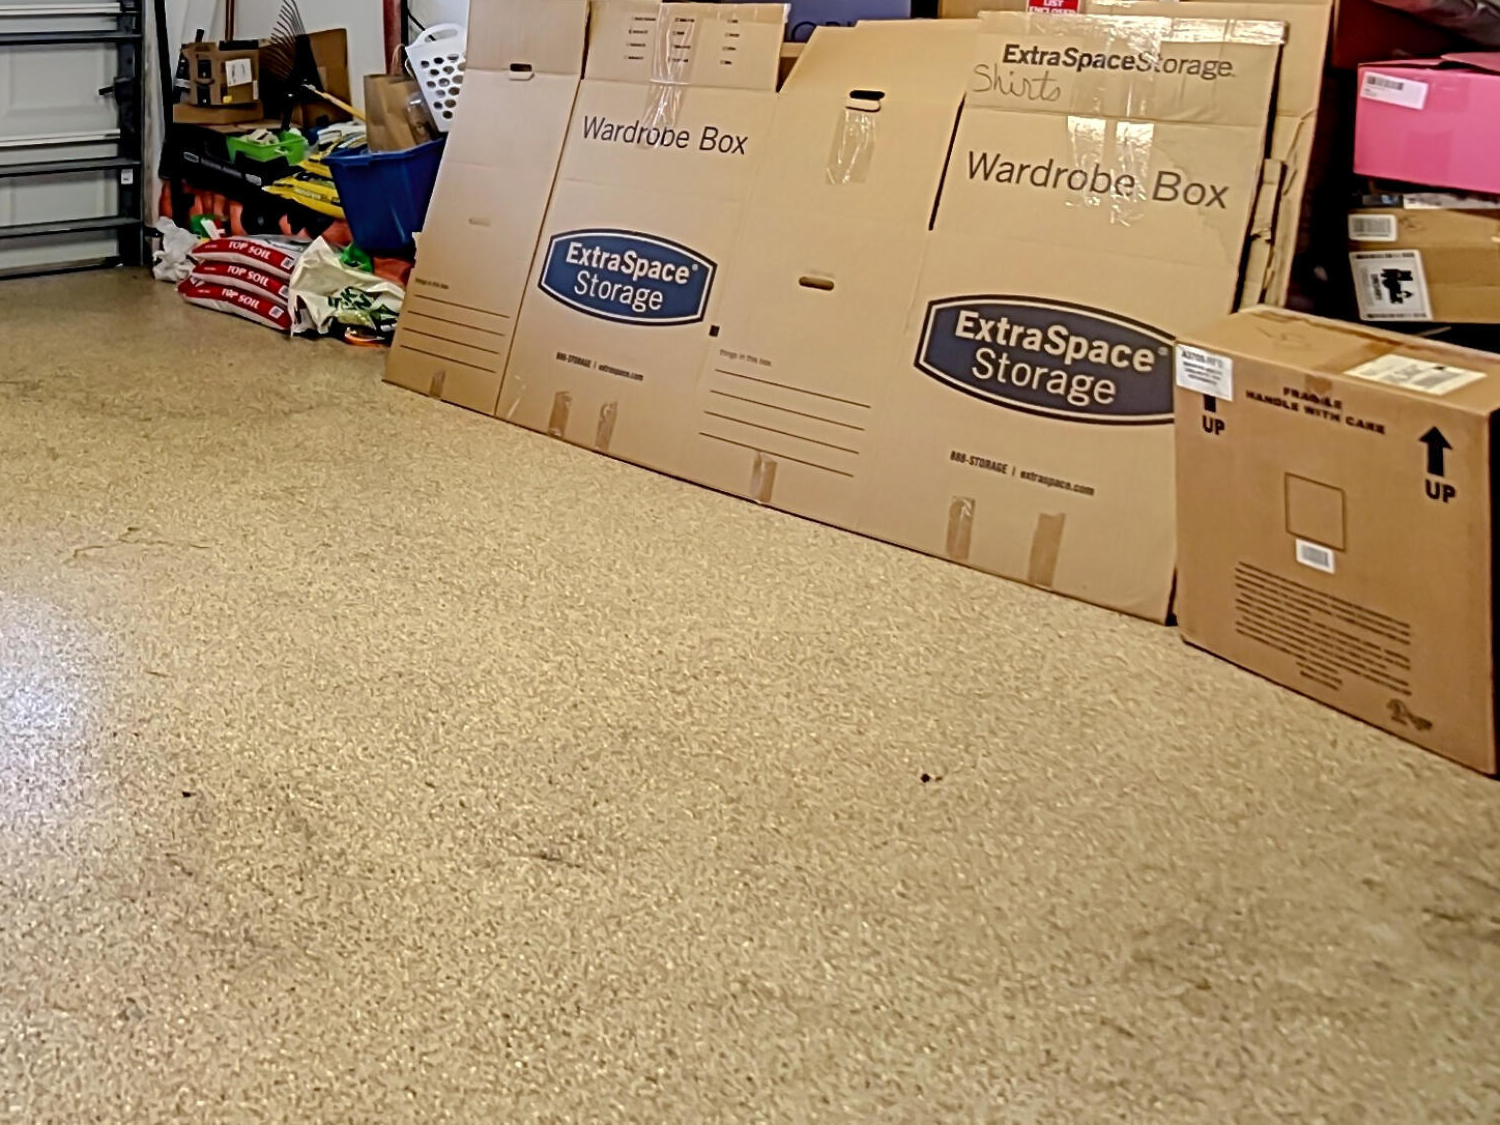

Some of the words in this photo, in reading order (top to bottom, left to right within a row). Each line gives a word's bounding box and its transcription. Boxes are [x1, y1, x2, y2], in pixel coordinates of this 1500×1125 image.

[583, 115, 690, 149] Wardrobe
[699, 125, 749, 155] Box
[968, 150, 1136, 197] Wardrobe
[1152, 170, 1231, 210] Box
[228, 241, 248, 250] TOP
[248, 246, 271, 259] SOIL
[565, 241, 690, 285] ExtraSpace
[227, 265, 247, 275] TOP
[247, 271, 269, 287] SOIL
[574, 270, 664, 313] Storage
[221, 288, 239, 298] TOP
[238, 295, 260, 309] SOIL
[954, 310, 1155, 372] ExtraSpace
[971, 346, 1116, 407] Storage
[1246, 390, 1299, 412] HANDLE
[1303, 403, 1341, 423] WITH
[1345, 416, 1386, 435] CARE
[1282, 386, 1343, 410] FRAGILE
[1202, 415, 1226, 436] UP
[1019, 469, 1095, 496] extraspace.com
[1425, 478, 1456, 503] UP
